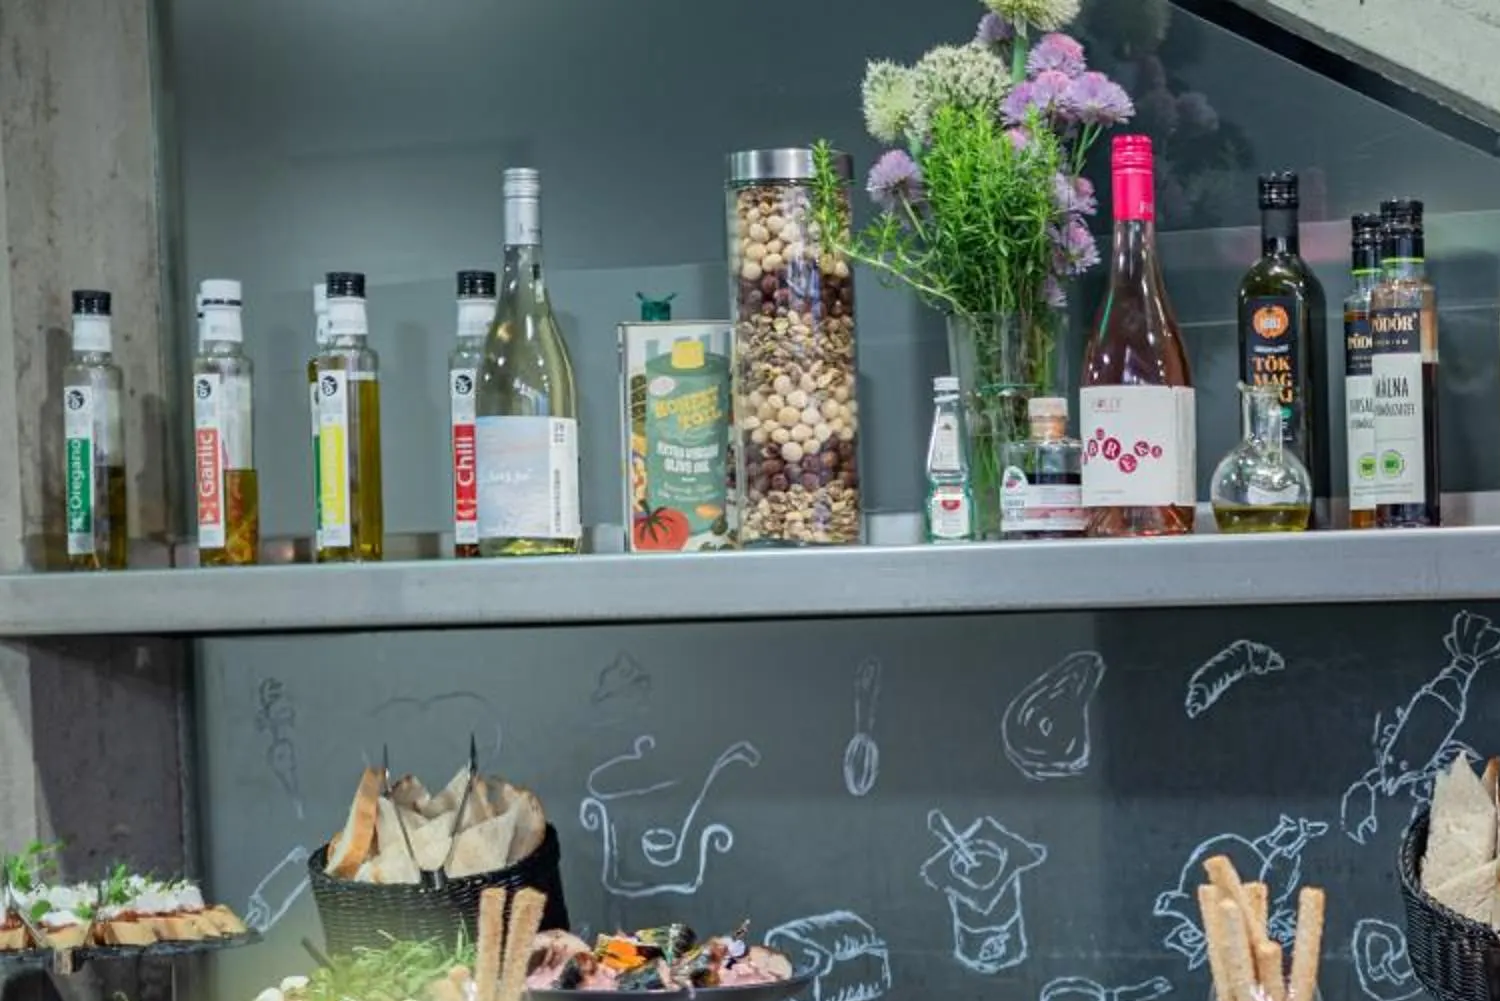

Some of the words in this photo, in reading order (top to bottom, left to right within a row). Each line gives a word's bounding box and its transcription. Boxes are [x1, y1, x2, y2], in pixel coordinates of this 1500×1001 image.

[1253, 353, 1290, 371] TÖK
[70, 439, 87, 508] Oregano
[197, 433, 214, 498] Garlic
